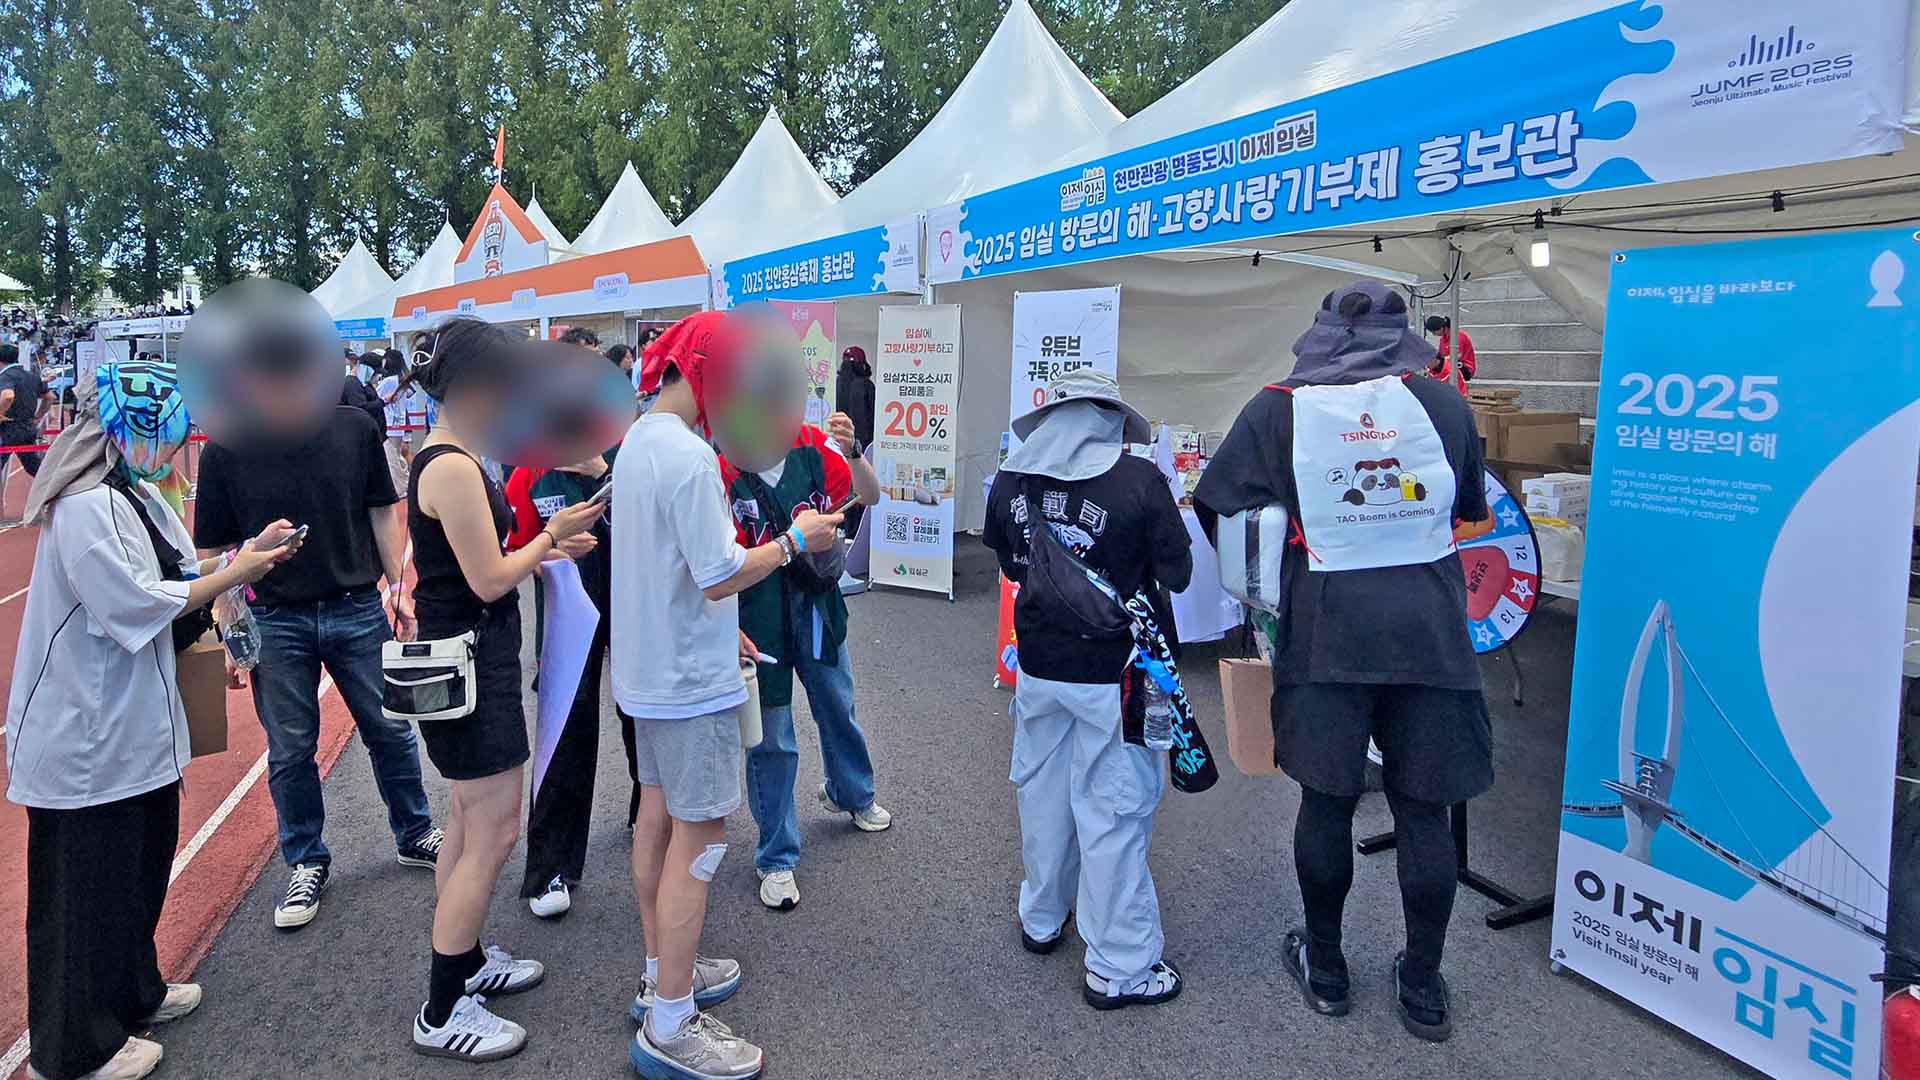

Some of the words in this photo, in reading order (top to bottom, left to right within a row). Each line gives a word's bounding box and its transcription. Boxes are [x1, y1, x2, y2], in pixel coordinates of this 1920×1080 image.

[1690, 73, 1765, 97] JUMF
[1771, 54, 1853, 82] 2025
[1692, 95, 1723, 108] Jeonju
[1725, 86, 1770, 102] Ultimate
[1772, 80, 1803, 92] Music
[1806, 70, 1852, 86] Festival
[1114, 161, 1170, 192] 천만관광
[1172, 141, 1236, 179] 명품도시
[974, 232, 1015, 266] 2025
[1020, 220, 1055, 258] 임실
[1059, 207, 1121, 251] 방문의
[1414, 109, 1581, 195] 홍보관
[741, 271, 764, 296] 2025
[764, 257, 819, 291] 진안홍삼축제
[821, 251, 856, 284] 홍보관
[1667, 284, 1714, 304] 임실을
[1719, 279, 1796, 294] 바라보다
[905, 327, 932, 339] 임실에
[1041, 336, 1081, 357] 유튜브
[883, 372, 952, 384] 임실치즈&소시지
[1617, 372, 1779, 421] 2025
[930, 404, 948, 416] 할인
[1340, 430, 1398, 443] TSINGTAO
[1616, 424, 1661, 450] 임실
[1667, 427, 1743, 457] 방문의
[1748, 433, 1777, 460] 해
[1649, 472, 1657, 480] a
[1692, 476, 1729, 487] where
[1668, 484, 1690, 495] and
[1336, 514, 1357, 524] TAO
[1359, 513, 1388, 522] Boom
[1389, 511, 1398, 519] is
[1399, 507, 1436, 519] Coming
[1514, 545, 1528, 561] 12
[1516, 583, 1526, 594] 2
[1500, 608, 1515, 624] 13
[1574, 870, 1702, 954] 이제
[1571, 927, 1602, 950] Visit
[1604, 944, 1638, 969] Imsil
[1640, 962, 1675, 985] year
[1572, 911, 1611, 937] 2025
[1615, 930, 1640, 953] 임실
[1642, 943, 1682, 972] 방문의
[1684, 964, 1699, 982] 해
[1712, 940, 1857, 1080] 임실
